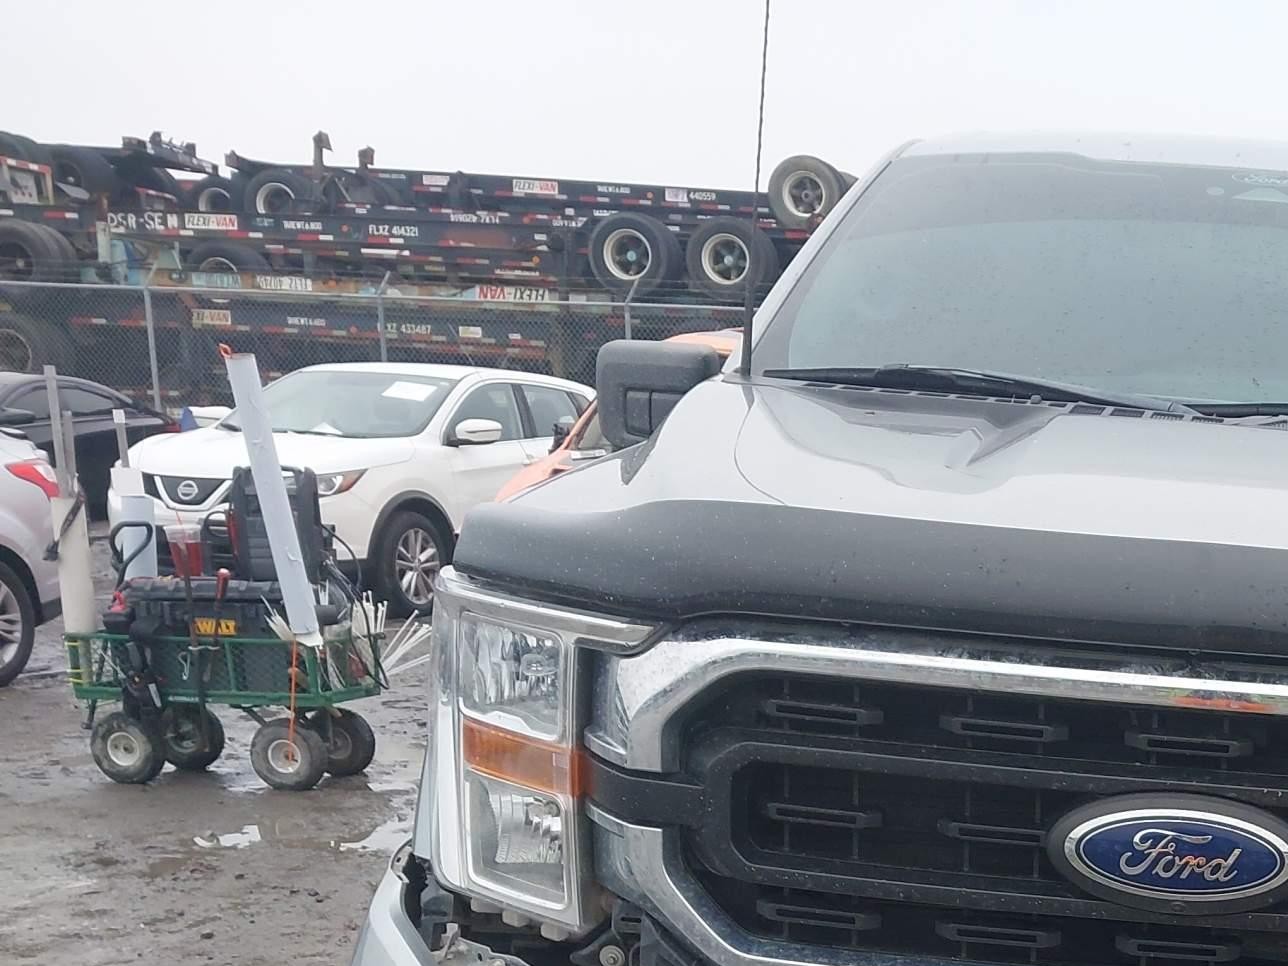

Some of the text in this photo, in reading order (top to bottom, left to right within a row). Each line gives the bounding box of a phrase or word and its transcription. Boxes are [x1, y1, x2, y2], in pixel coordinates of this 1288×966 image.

[512, 180, 558, 194] FLEXI-VAN
[186, 213, 237, 228] FLEXI-VAN
[368, 224, 390, 237] FLXZ
[479, 285, 547, 302] FLEXI-VAN
[1119, 827, 1243, 883] Ford
